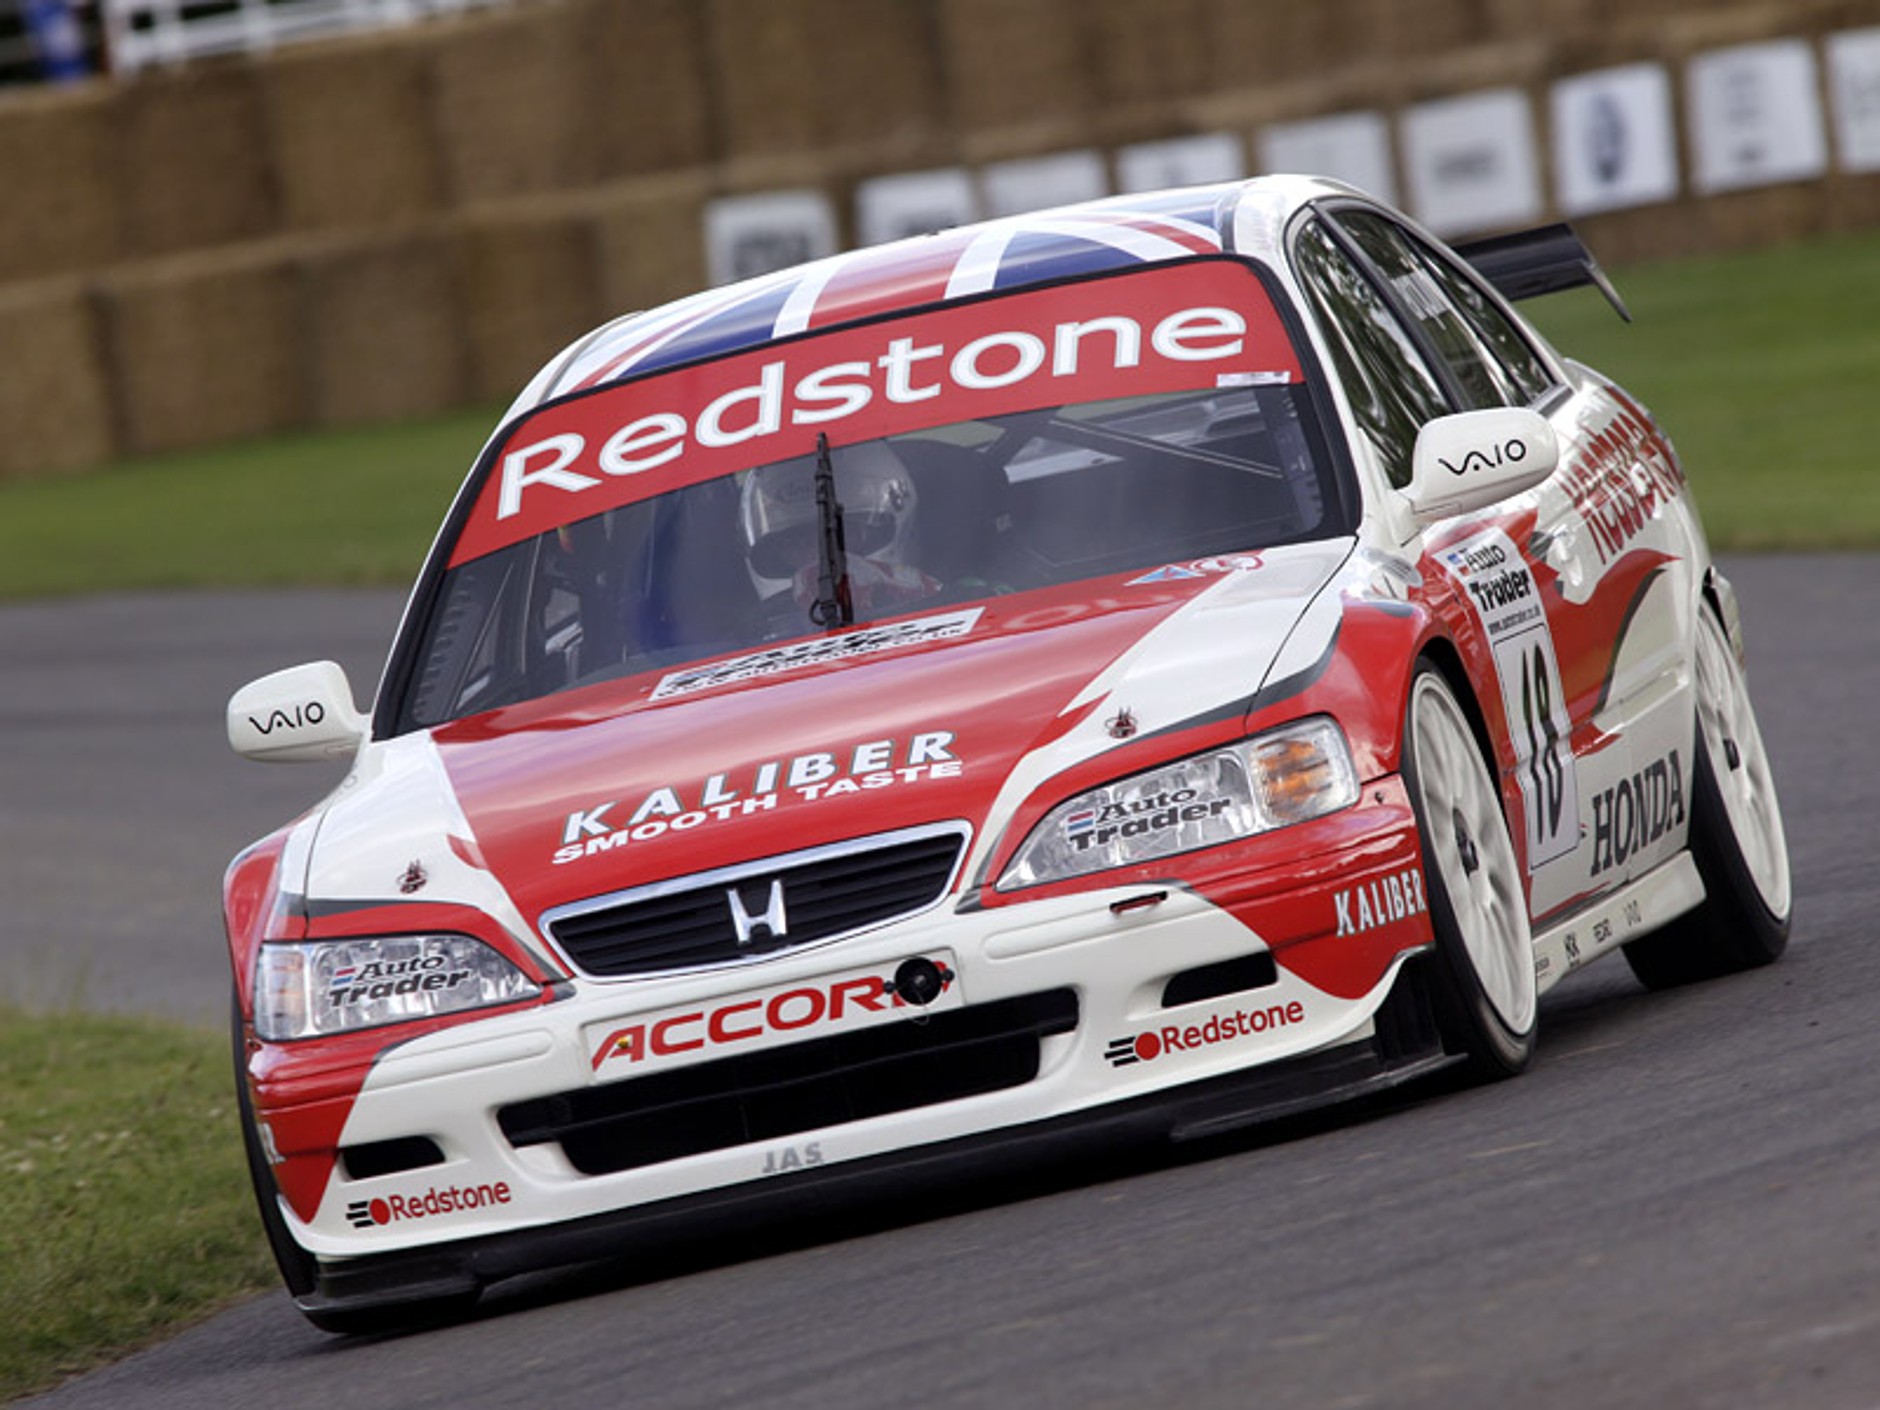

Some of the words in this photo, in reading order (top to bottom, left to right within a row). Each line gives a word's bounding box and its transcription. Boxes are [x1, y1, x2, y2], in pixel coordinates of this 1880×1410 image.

[496, 305, 1246, 520] Redstone
[1438, 439, 1527, 476] VAIO
[1464, 545, 1507, 572] Auto
[1469, 569, 1531, 612] Trader
[249, 702, 325, 734] VAIO
[1521, 640, 1563, 844] 18
[562, 730, 957, 846] KALIBER
[1096, 789, 1197, 823] Auto
[552, 794, 778, 865] SMOOTH
[797, 760, 963, 802] TASTE
[1069, 798, 1231, 851] Trader
[1591, 749, 1686, 877] HONDA
[1334, 868, 1427, 937] KALIBER
[329, 971, 470, 1007] Trader
[355, 956, 444, 981] Auto
[1160, 1000, 1304, 1054] Redstone
[762, 1142, 822, 1173] JAS
[388, 1181, 512, 1221] Redstone
